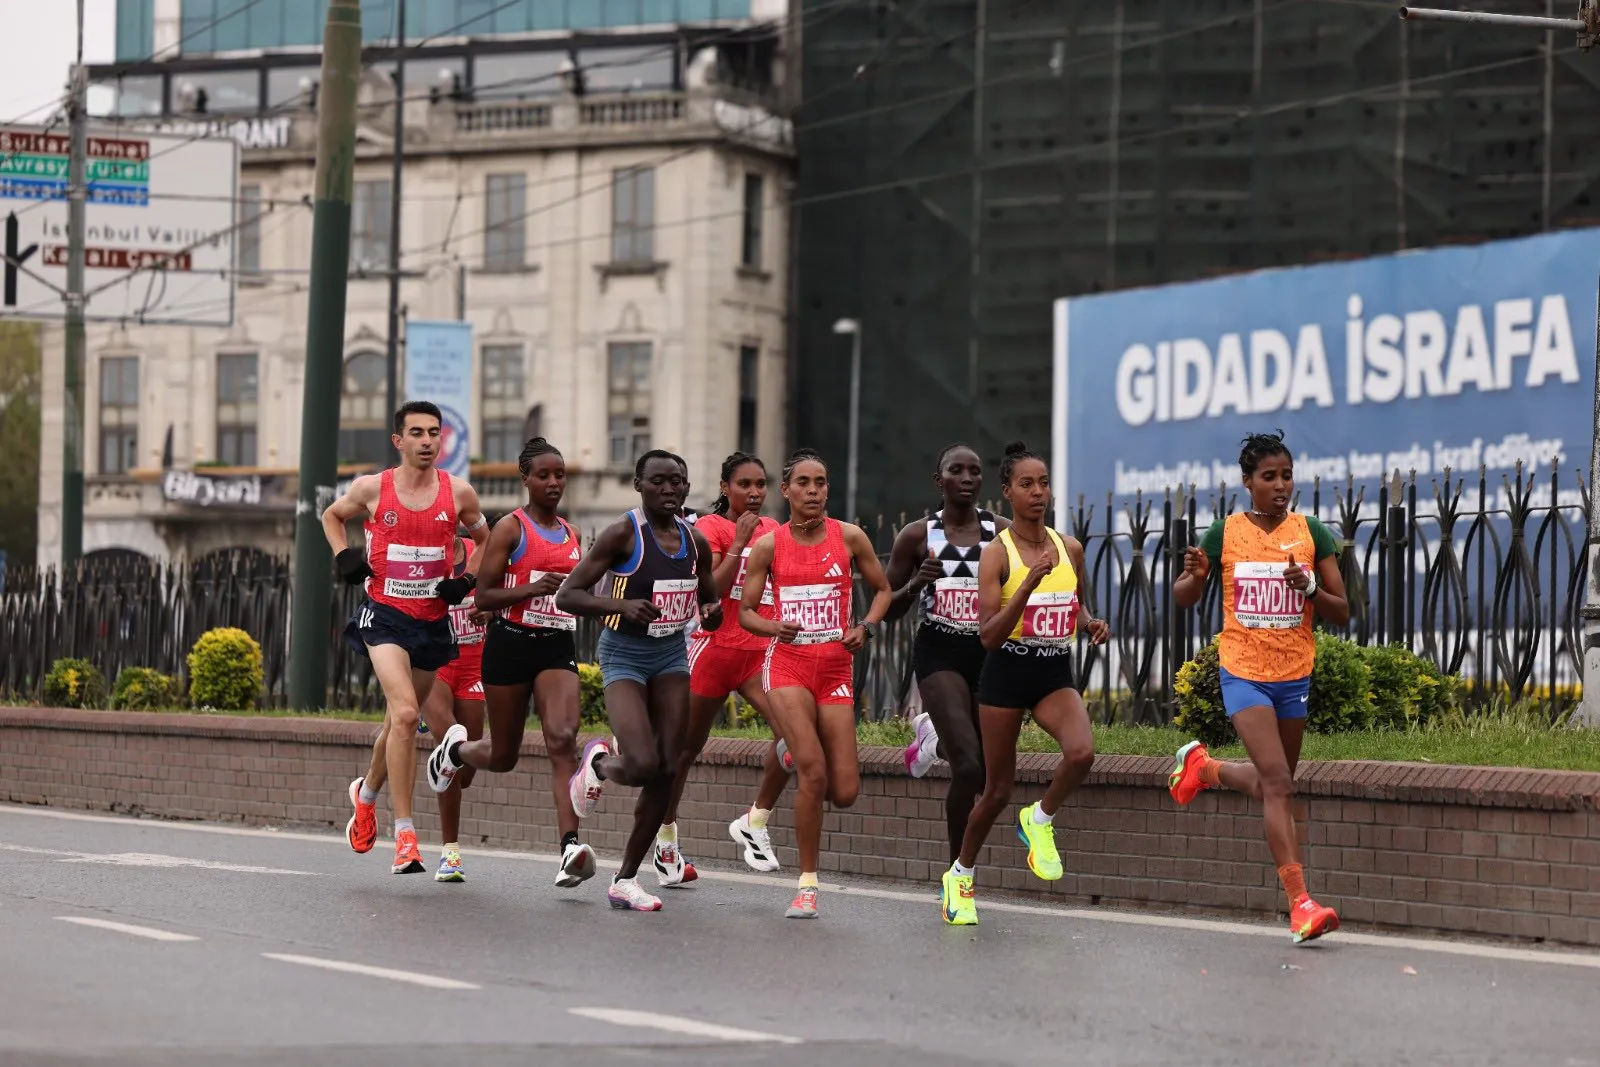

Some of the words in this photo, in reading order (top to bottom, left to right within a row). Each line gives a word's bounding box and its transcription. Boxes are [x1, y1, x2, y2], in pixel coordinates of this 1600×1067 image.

[1, 132, 148, 158] Sultanhmet
[1, 158, 71, 179] Avrasy
[43, 216, 139, 241] İstnbul
[44, 246, 119, 267] Kaalı
[1116, 323, 1334, 426] GIDADA
[1346, 293, 1580, 405] İSRAFA
[408, 564, 425, 577] 24
[391, 587, 430, 597] MARATHON
[1032, 605, 1073, 637] GETE
[1001, 641, 1029, 655] RO
